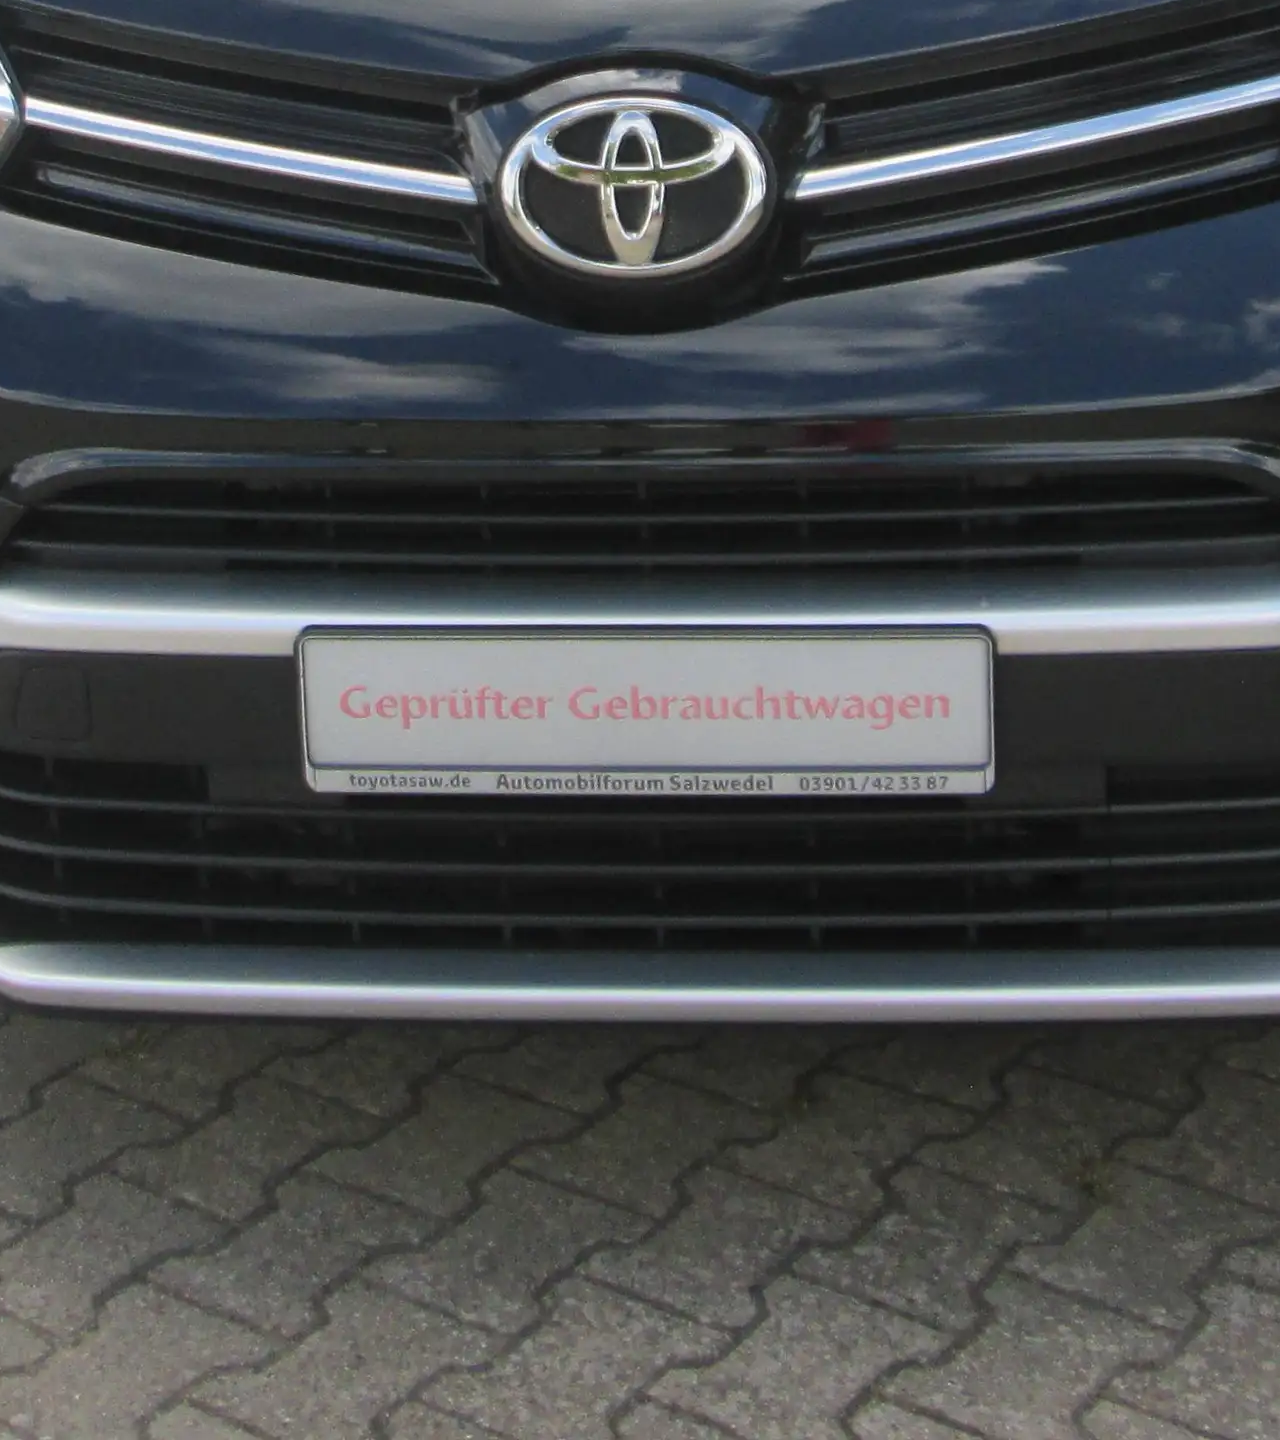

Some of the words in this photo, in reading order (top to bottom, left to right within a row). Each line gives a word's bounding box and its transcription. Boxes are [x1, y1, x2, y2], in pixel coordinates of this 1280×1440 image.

[339, 685, 553, 730] Geprüfter
[568, 685, 950, 731] Gebrauchtwagen
[348, 772, 471, 791] toyotasaw.de
[495, 772, 664, 793] Automobilforum
[669, 774, 774, 793] Salzwedel
